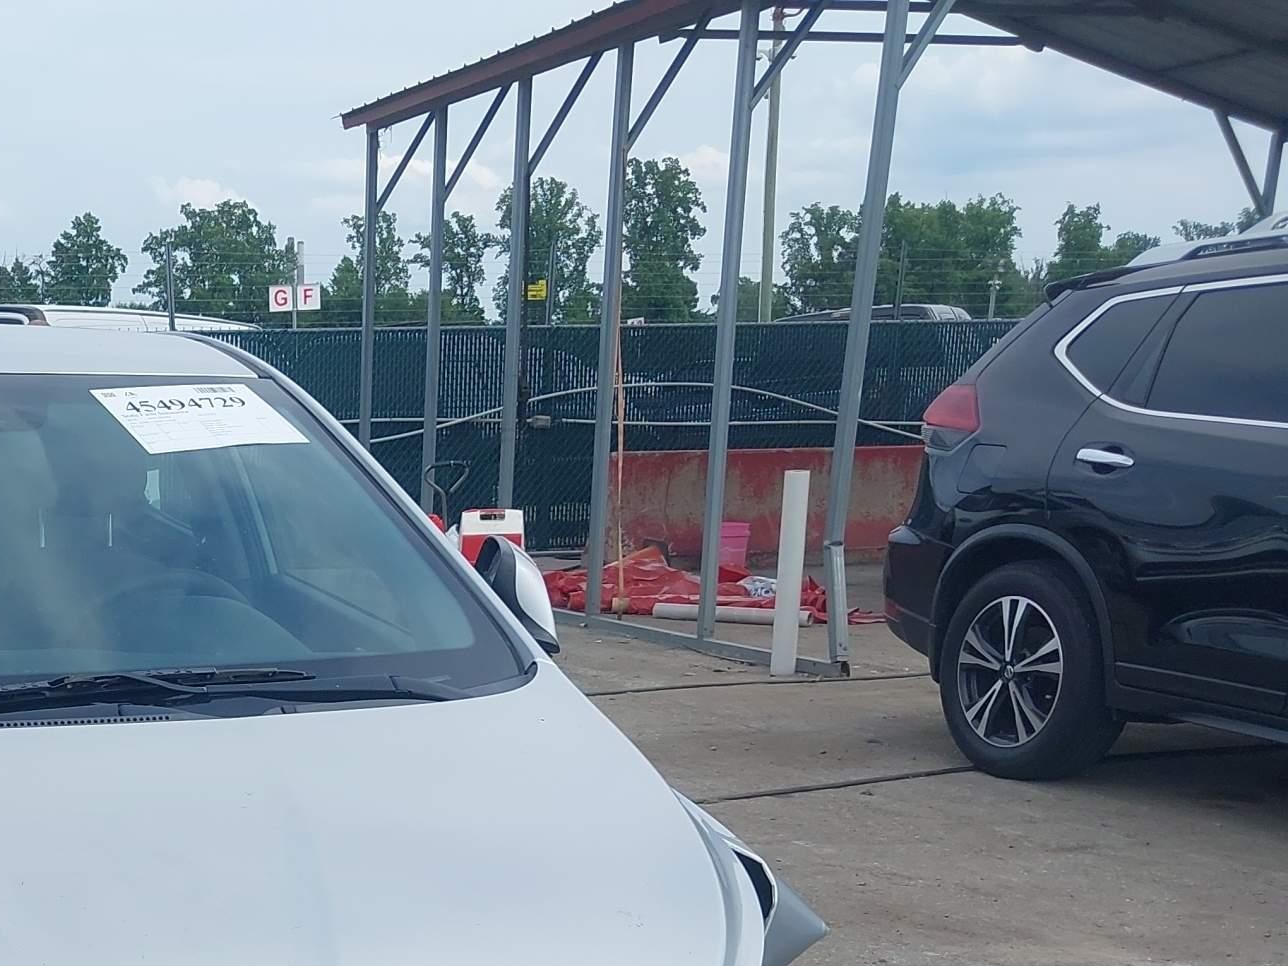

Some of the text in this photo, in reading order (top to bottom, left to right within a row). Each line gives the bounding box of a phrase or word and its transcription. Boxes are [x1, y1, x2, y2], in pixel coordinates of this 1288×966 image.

[274, 288, 314, 307] G F
[126, 396, 247, 413] 45494729
